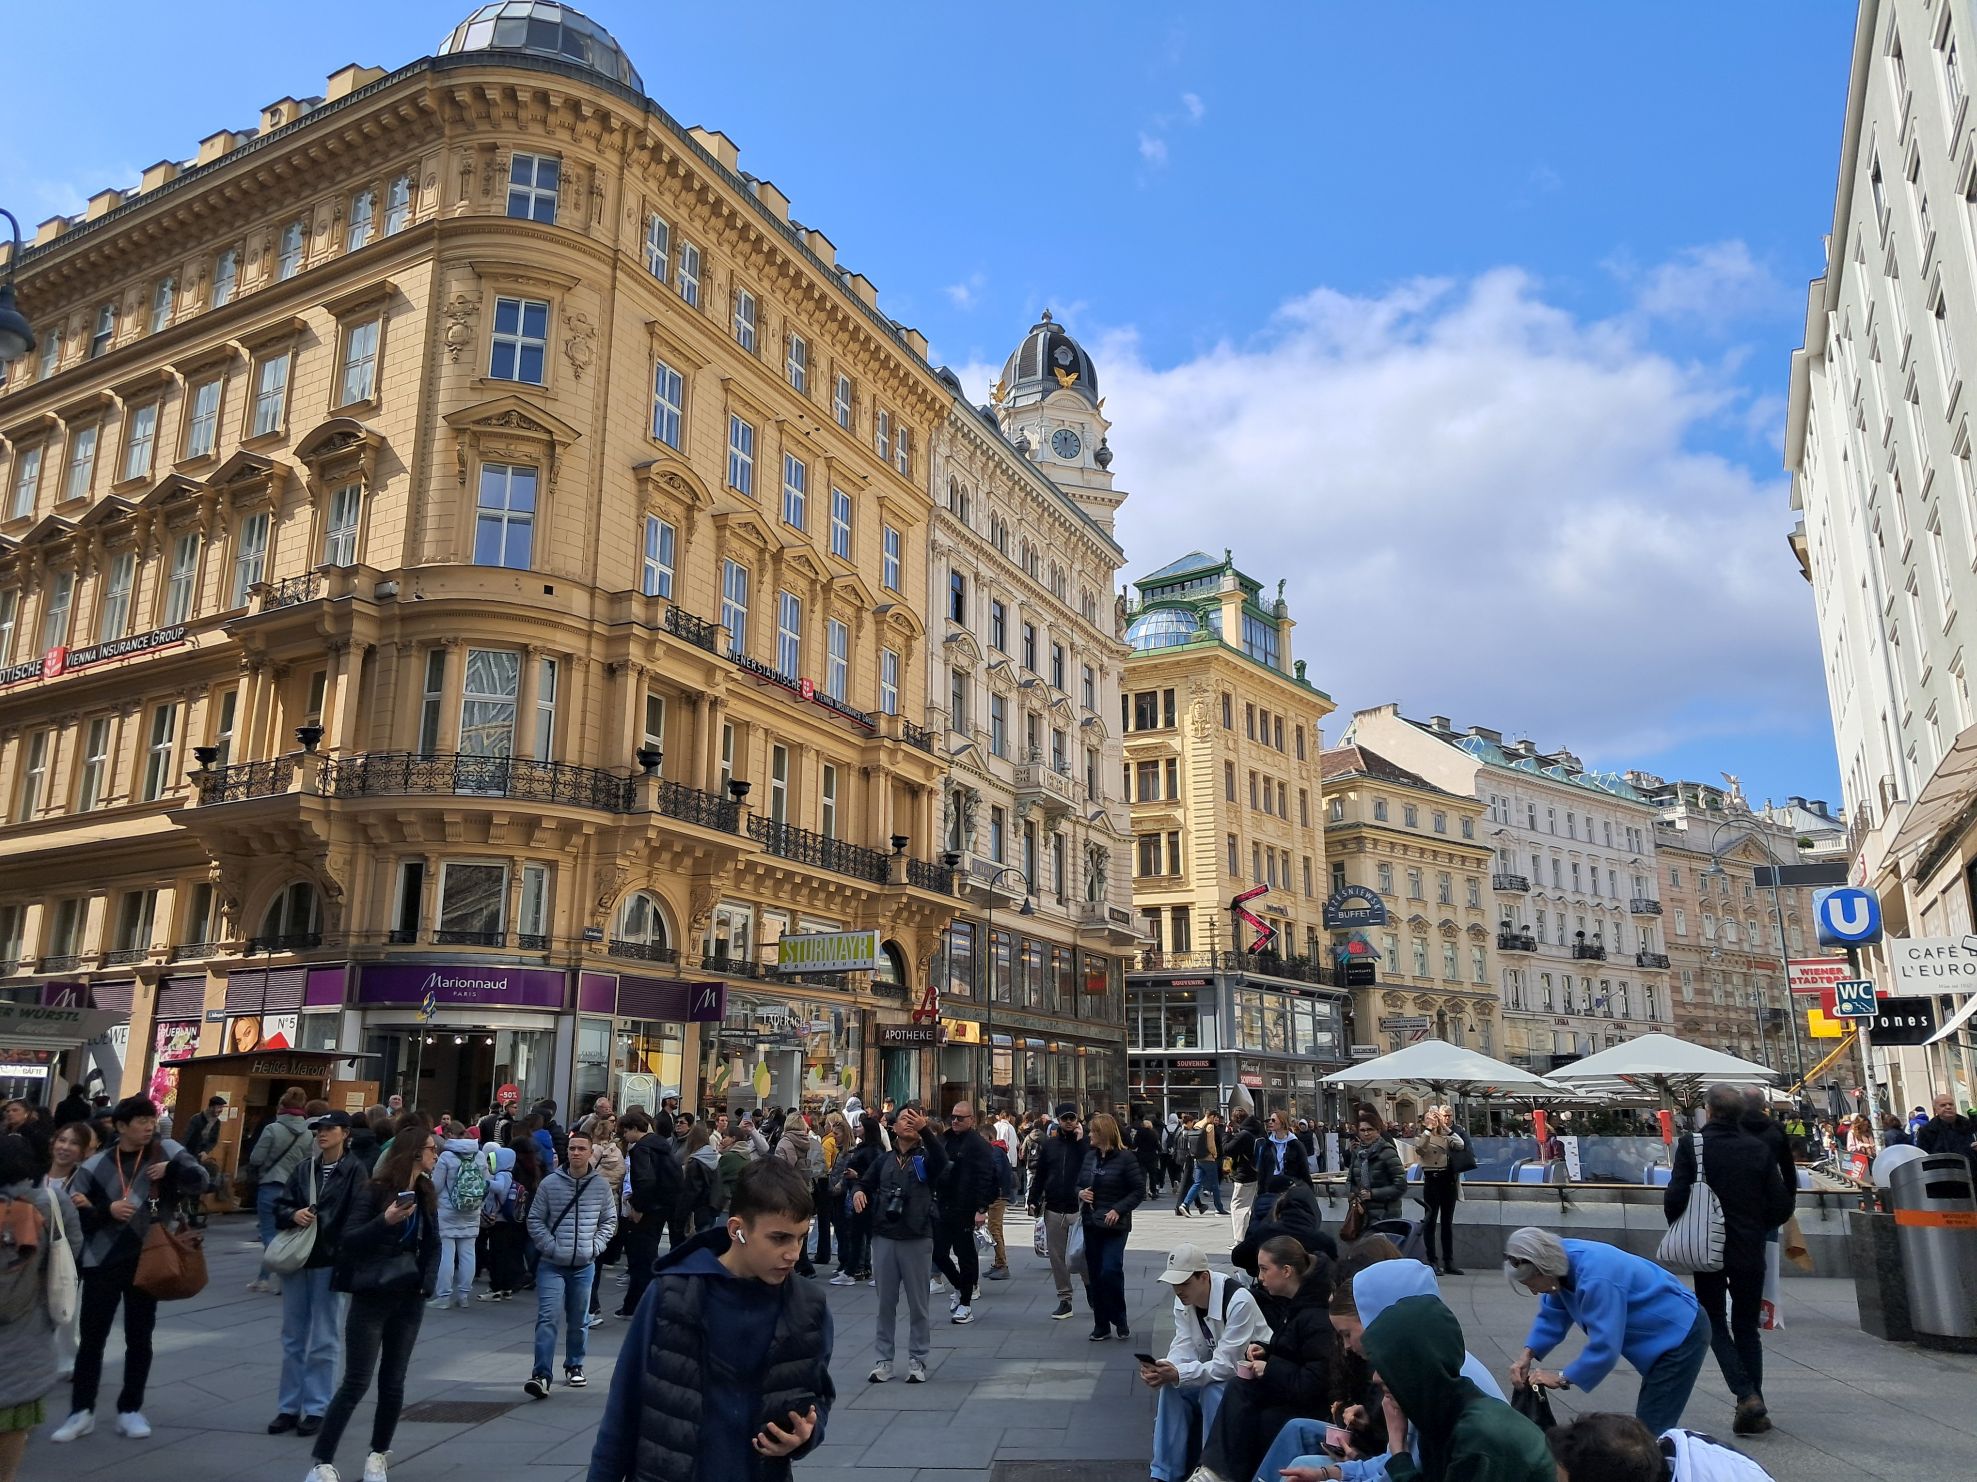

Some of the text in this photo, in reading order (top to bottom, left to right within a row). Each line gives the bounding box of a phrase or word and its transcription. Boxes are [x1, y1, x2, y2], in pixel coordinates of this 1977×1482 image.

[66, 627, 185, 668] VIENNA INSURANCE GROUP
[726, 649, 757, 672] WIENER
[815, 691, 834, 708] VIENNA
[835, 701, 861, 723] INSURANCE
[1338, 909, 1371, 919] BUFFET
[1827, 897, 1870, 935] U
[785, 935, 868, 964] STURMAYR
[1908, 943, 1959, 960] CAFÉ
[1799, 967, 1844, 976] WIENER
[420, 972, 508, 992] Marionnaud
[1838, 983, 1872, 1000] WC
[19, 1006, 81, 1022] WÜRSTL
[1868, 1014, 1928, 1030] Jones
[885, 1029, 934, 1041] APOTHEKE
[251, 1060, 329, 1076] Heiße Maroni
